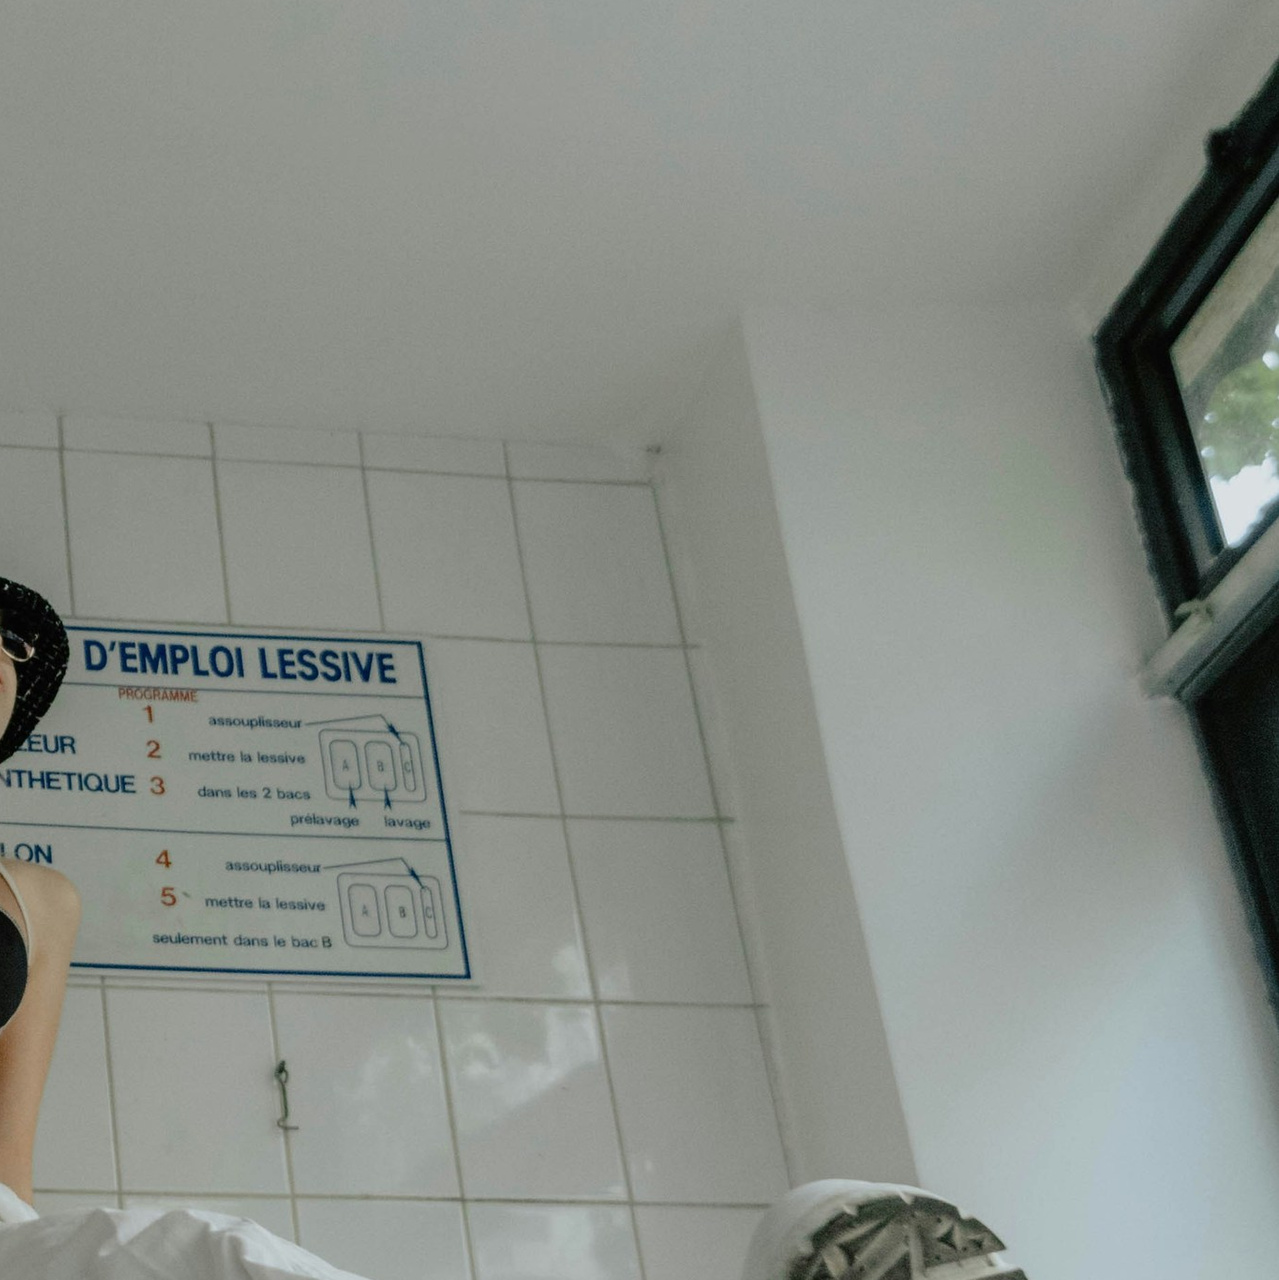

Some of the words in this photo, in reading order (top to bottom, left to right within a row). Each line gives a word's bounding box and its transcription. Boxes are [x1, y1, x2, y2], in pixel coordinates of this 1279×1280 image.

[83, 640, 244, 678] D'EMPLOI
[258, 648, 397, 684] LESSIVE
[118, 686, 198, 702] PROGRAMME
[142, 705, 154, 724] 1
[209, 716, 302, 730] assouplisseur
[147, 740, 161, 759] 2
[189, 751, 235, 762] mettre
[240, 751, 253, 763] la
[257, 752, 305, 764] lessive
[150, 776, 165, 795] 3
[198, 786, 232, 798] dans
[237, 787, 257, 799] les
[262, 787, 272, 799] 2
[277, 788, 311, 800] bacs
[384, 816, 430, 830] lavage
[156, 850, 172, 868] 4
[226, 860, 321, 874] assouplisseur
[161, 887, 177, 907] 5
[205, 897, 253, 908] mettre
[259, 898, 271, 909] la
[276, 898, 325, 911] lessive
[153, 933, 227, 945] seulement
[234, 935, 268, 947] dans
[274, 936, 286, 947] le
[291, 936, 318, 948] bac
[322, 936, 332, 949] B
